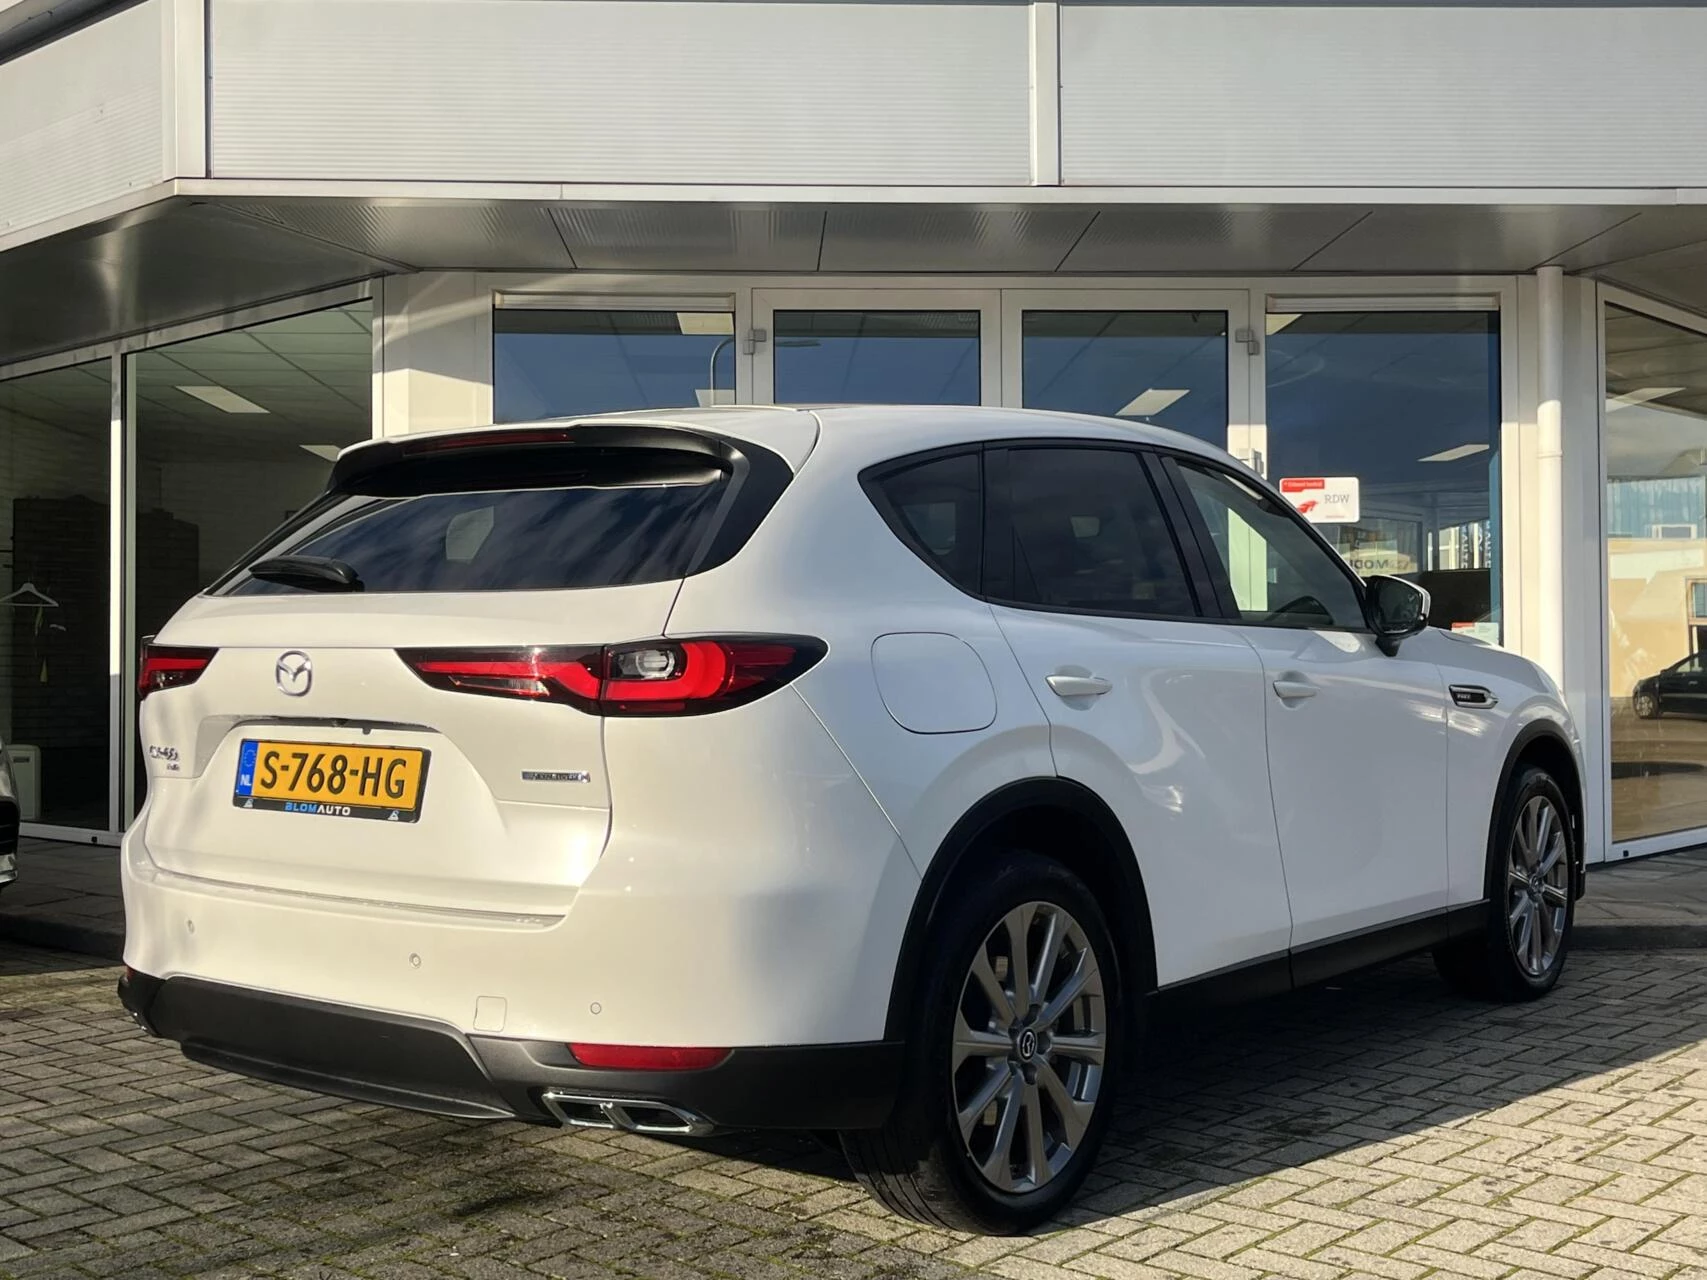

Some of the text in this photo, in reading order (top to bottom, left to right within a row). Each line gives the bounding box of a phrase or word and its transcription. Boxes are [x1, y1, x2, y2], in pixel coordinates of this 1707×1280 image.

[1324, 494, 1350, 504] RDW
[240, 774, 251, 786] NL
[260, 751, 407, 799] S-768-HG
[284, 802, 351, 816] BLOMAUTO
